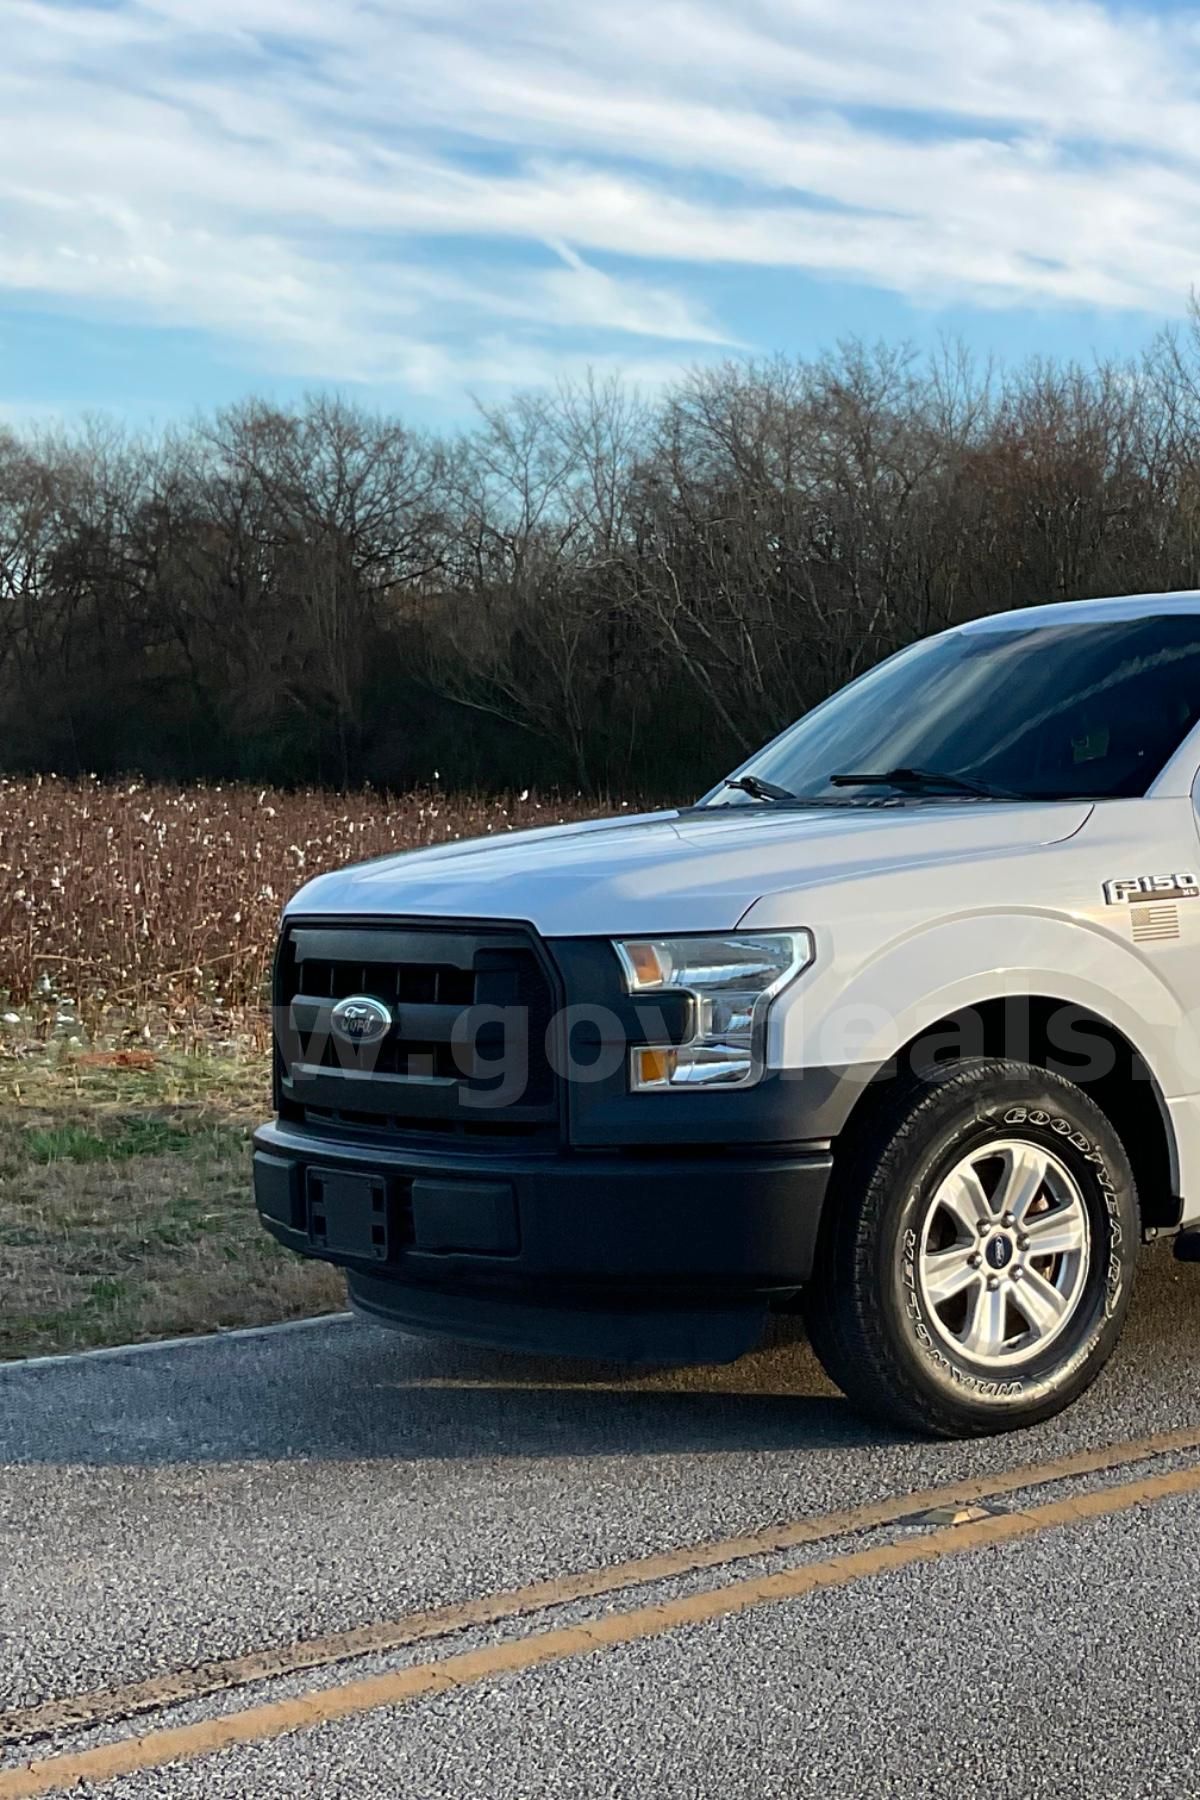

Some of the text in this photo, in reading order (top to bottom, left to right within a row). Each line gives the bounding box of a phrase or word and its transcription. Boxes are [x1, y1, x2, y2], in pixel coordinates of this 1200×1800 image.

[1182, 888, 1197, 896] XL
[341, 1006, 376, 1034] Ford
[1003, 1106, 1122, 1319] GOODYEAR
[902, 1228, 1024, 1397] WRANGLER
